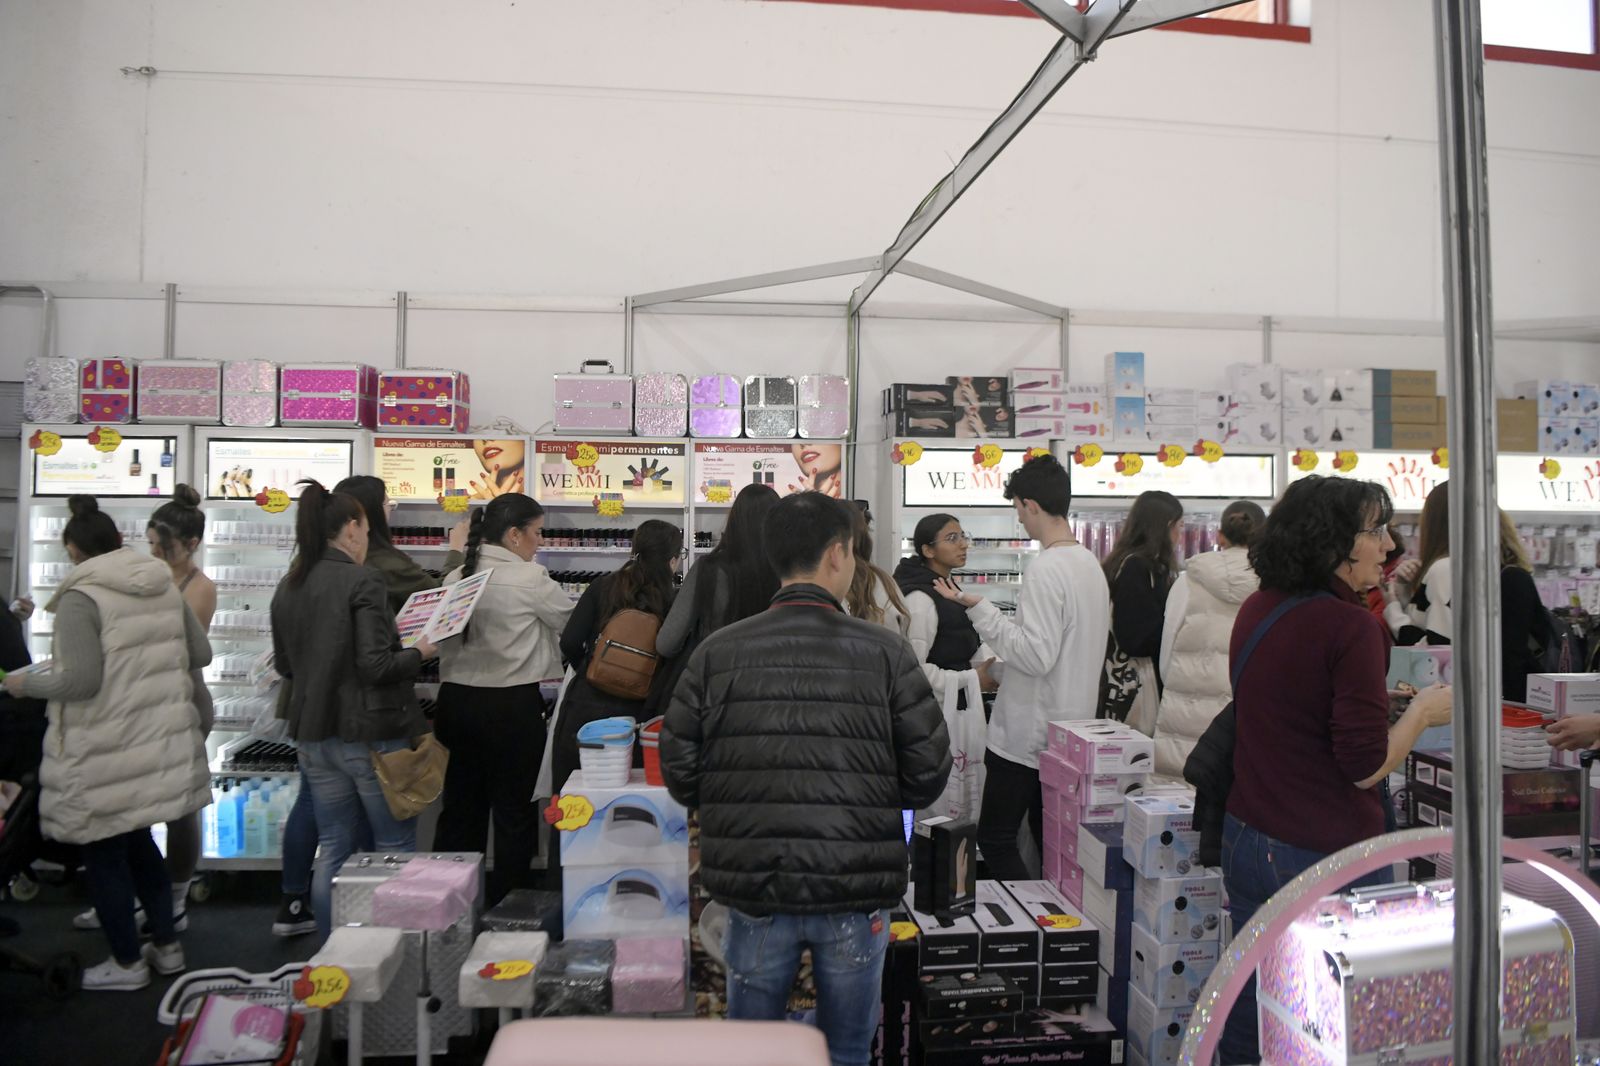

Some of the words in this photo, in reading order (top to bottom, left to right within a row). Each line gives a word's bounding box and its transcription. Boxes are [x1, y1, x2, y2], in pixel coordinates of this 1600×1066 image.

[382, 440, 404, 448] Nueva
[404, 440, 425, 448] Gama
[426, 440, 436, 448] de
[436, 440, 466, 448] Esmaltes
[703, 445, 724, 453] Nueva
[724, 445, 746, 453] Gama
[746, 445, 755, 453] de
[442, 453, 460, 467] Free
[760, 458, 779, 471] Free
[541, 473, 610, 489] WEMMI
